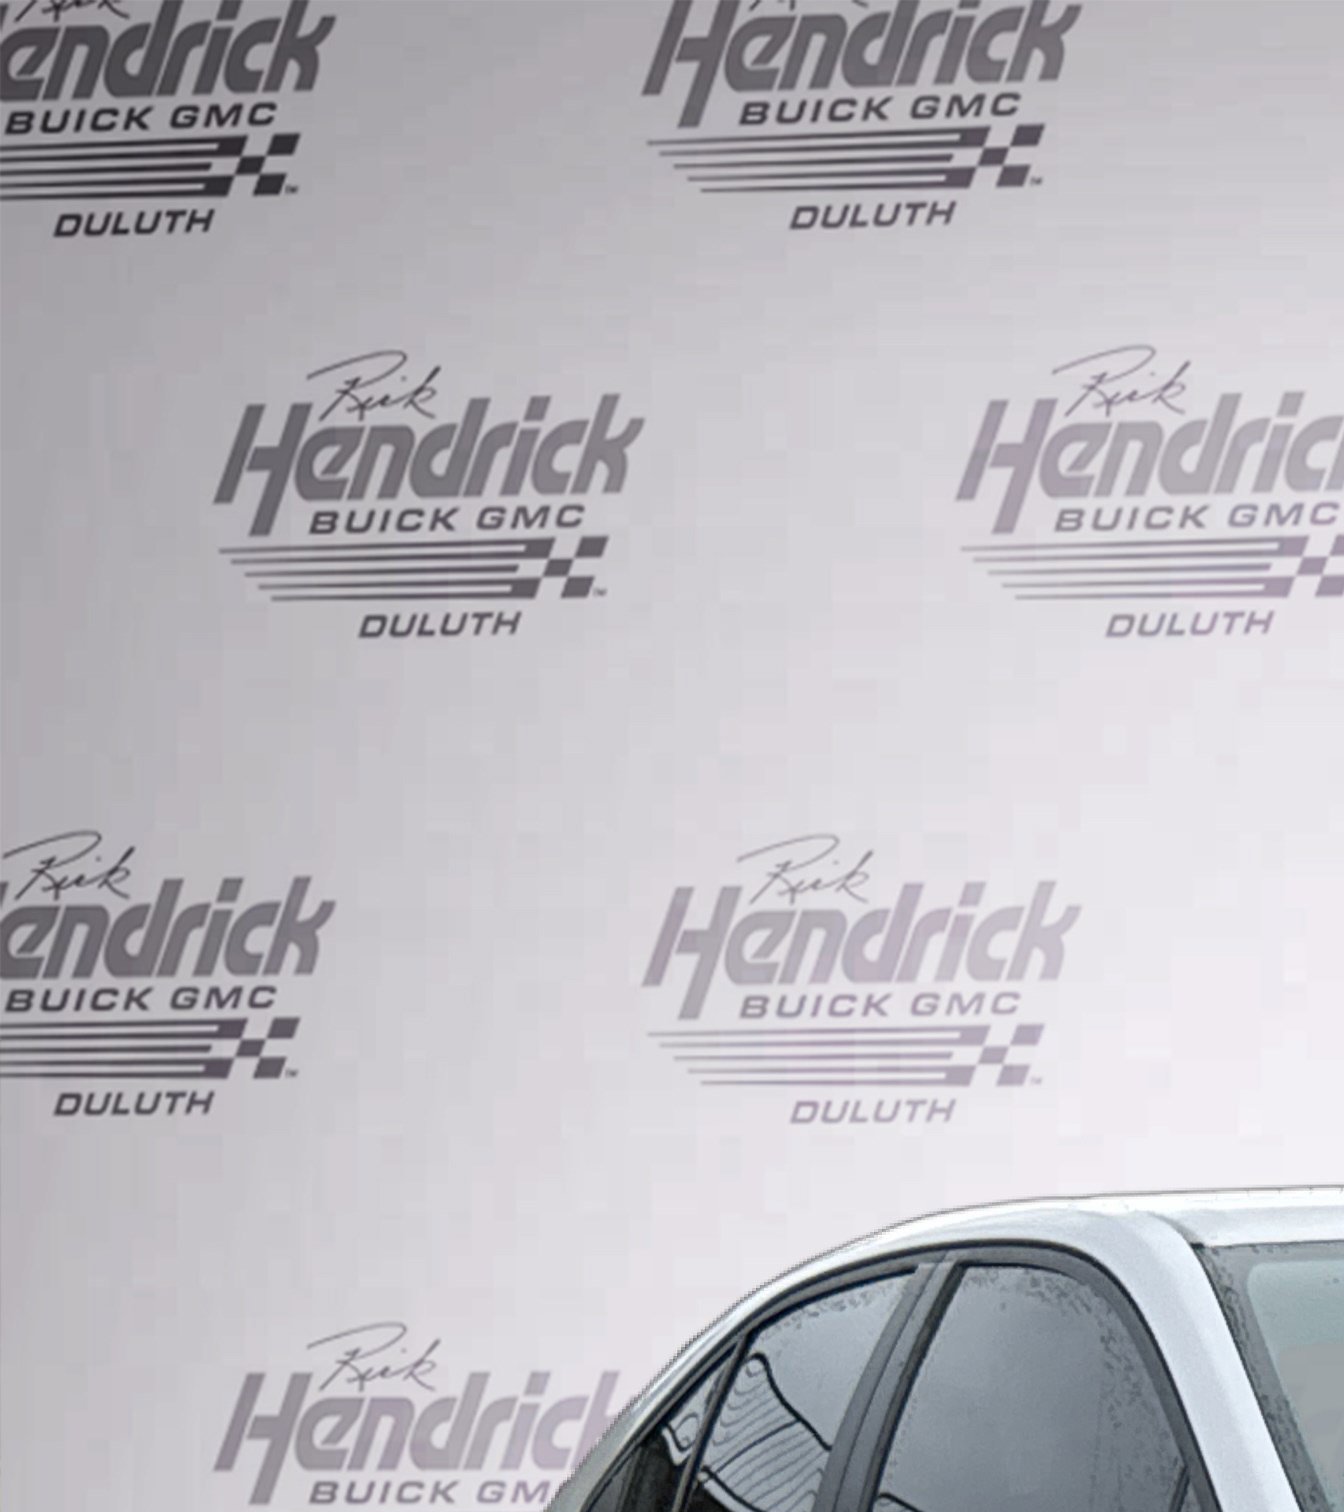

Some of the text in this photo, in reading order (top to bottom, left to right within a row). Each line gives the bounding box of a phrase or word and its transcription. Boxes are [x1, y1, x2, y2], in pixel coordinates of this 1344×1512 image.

[0, 0, 336, 101] endrick
[641, 0, 1081, 128] Hendrick
[4, 102, 278, 135] BUICK GMC
[738, 92, 1022, 126] BUICK GMC
[53, 208, 215, 237] DULUTH
[789, 200, 956, 230] DULUTH
[213, 394, 644, 536] Hendrick
[309, 504, 585, 535] BUICK GMC
[1053, 501, 1342, 533] BUICK GMC
[358, 610, 521, 638] DULUTH
[1104, 609, 1274, 638] DULUTH
[0, 875, 336, 979] endrick
[641, 880, 1082, 1020] Hendrick
[4, 985, 278, 1012] BUICK GMC
[738, 991, 1020, 1020] BUICK GMC
[53, 1090, 215, 1116] DULUTH
[789, 1098, 956, 1125] DULUTH
[308, 1480, 459, 1505] BUICK
